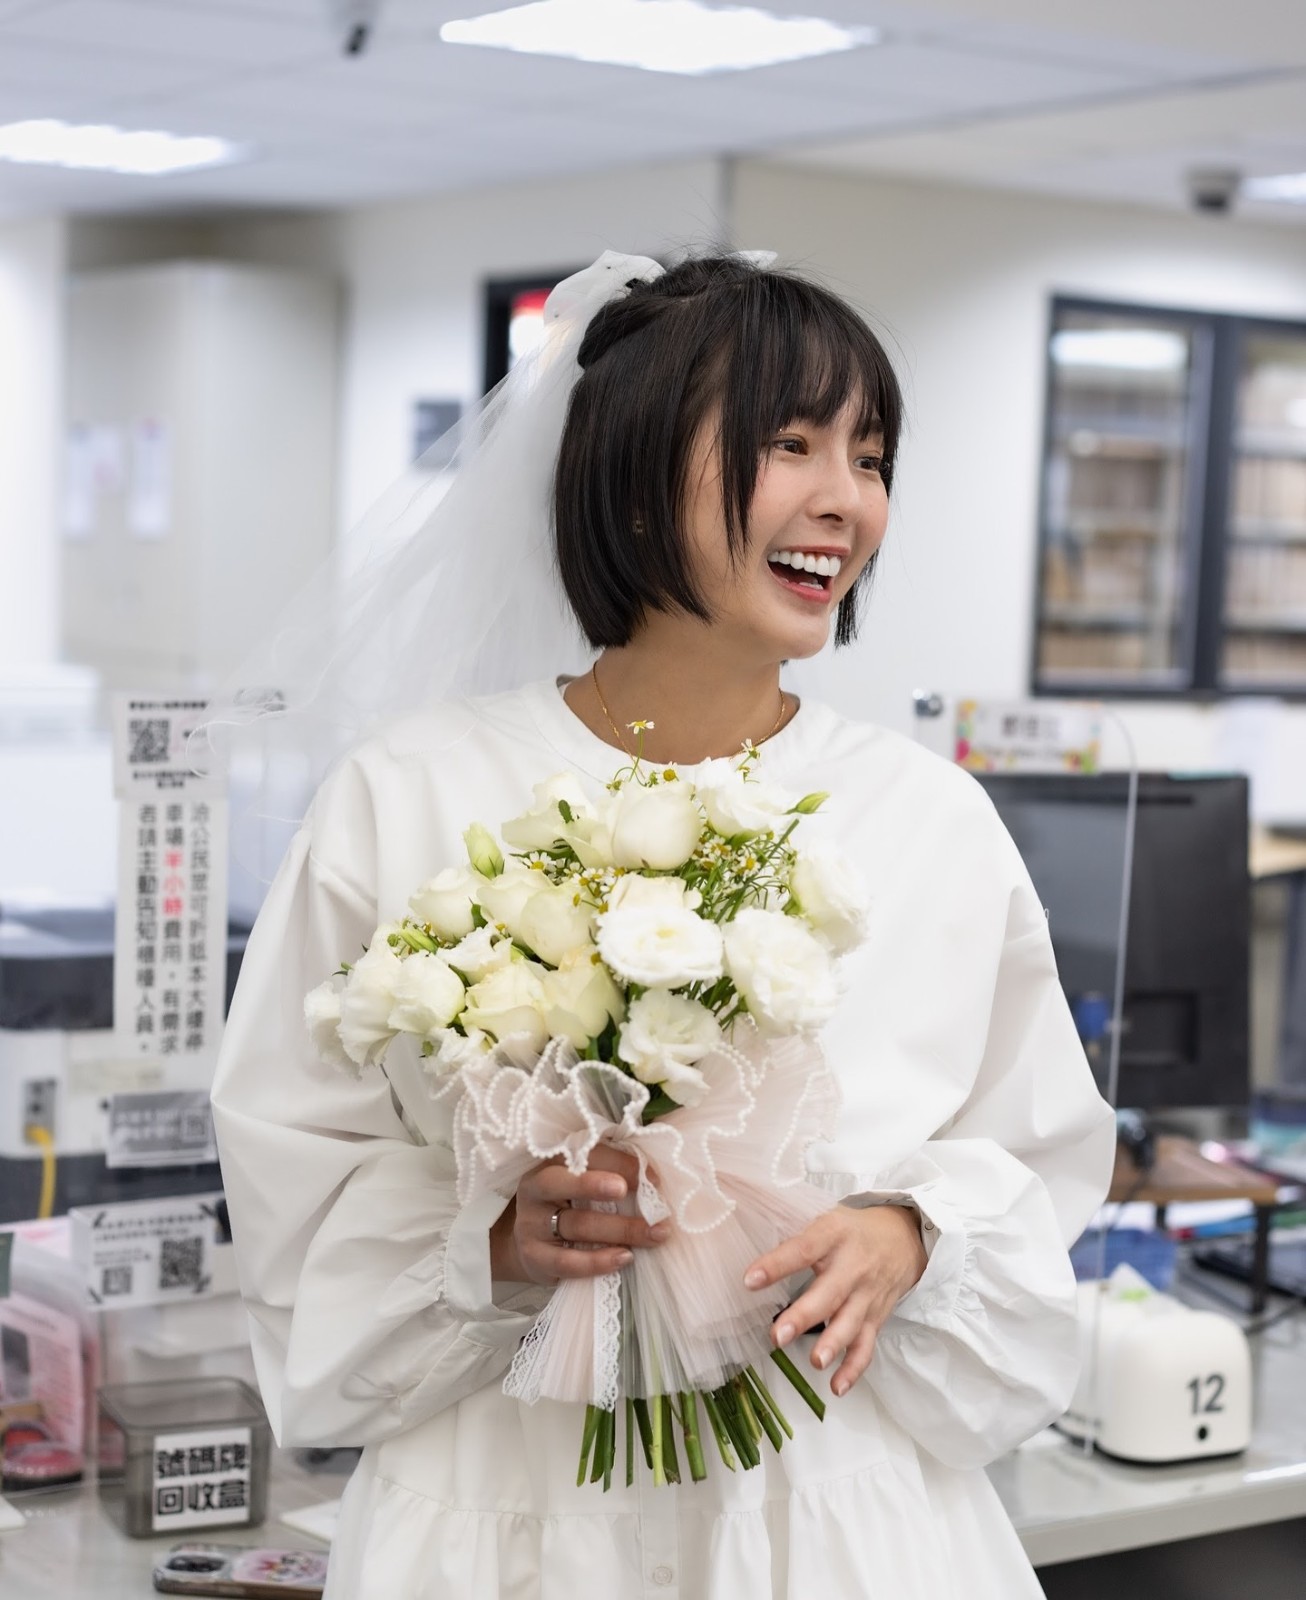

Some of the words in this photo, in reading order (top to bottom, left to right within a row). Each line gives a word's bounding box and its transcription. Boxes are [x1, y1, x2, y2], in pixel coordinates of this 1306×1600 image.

[1186, 1373, 1225, 1416] 12
[158, 1443, 247, 1478] 號碼牌
[158, 1480, 246, 1515] 回收盒
